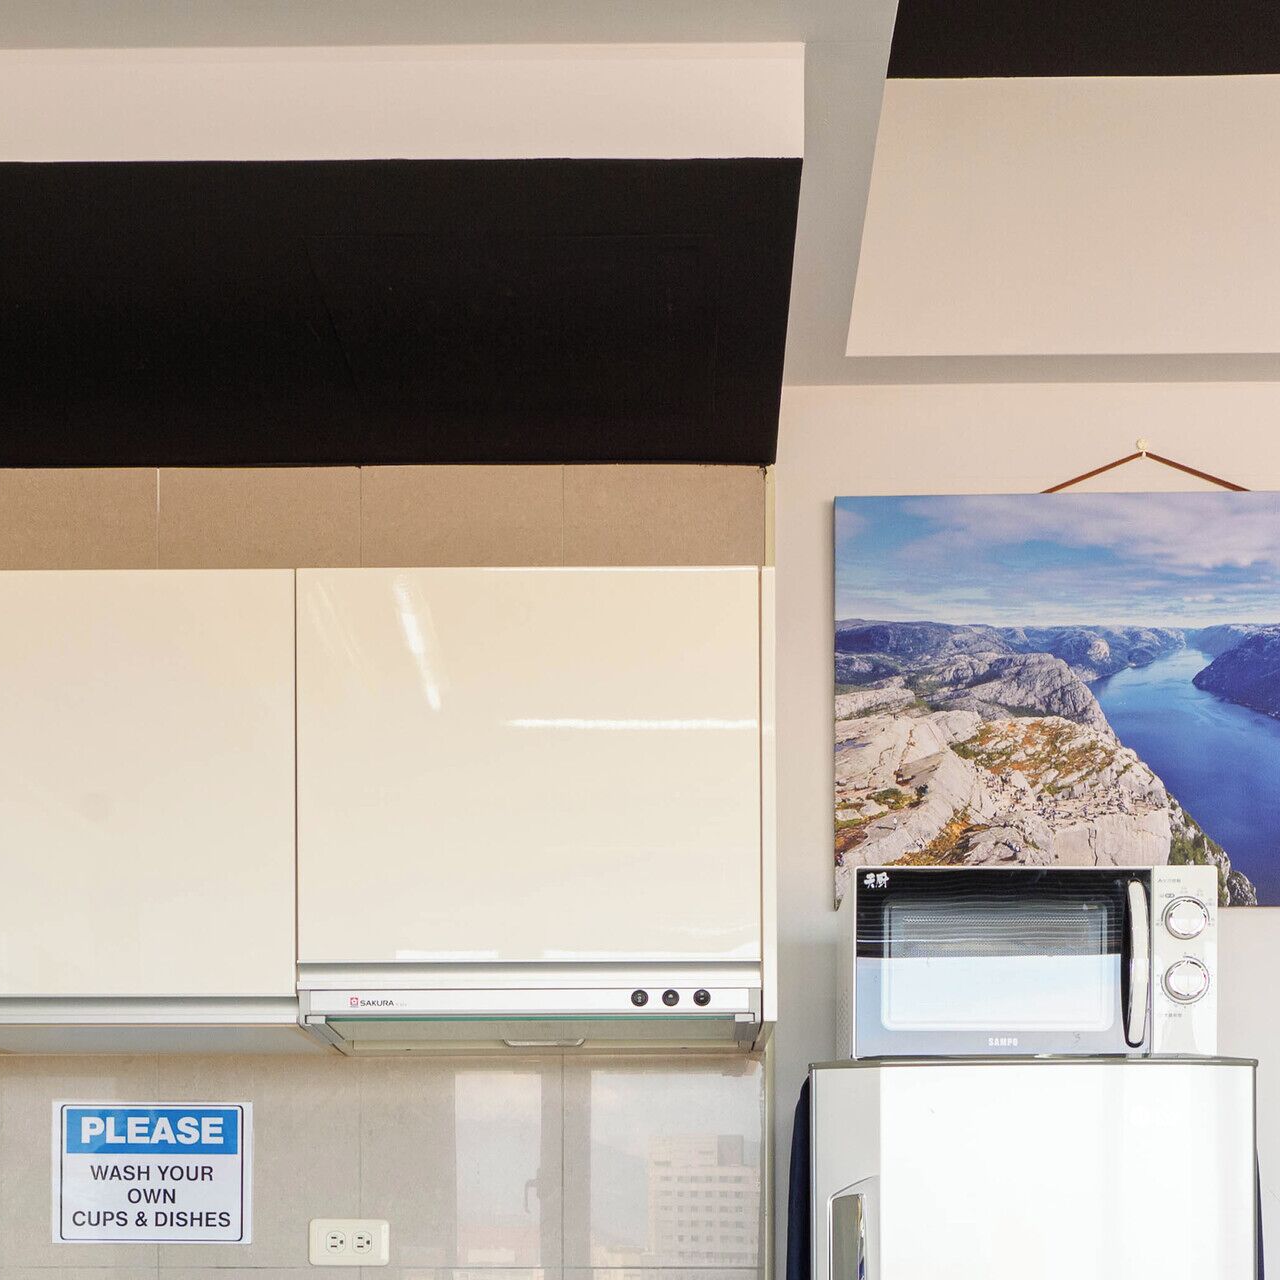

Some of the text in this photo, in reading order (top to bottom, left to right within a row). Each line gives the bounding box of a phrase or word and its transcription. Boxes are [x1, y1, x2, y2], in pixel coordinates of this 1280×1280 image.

[360, 999, 395, 1007] SAKURA
[988, 1037, 1019, 1047] SAMPO
[80, 1116, 225, 1145] PLEASE
[90, 1165, 214, 1182] WASH YOUR
[127, 1188, 176, 1204] OWN
[72, 1210, 231, 1228] CUPS & DISHES
